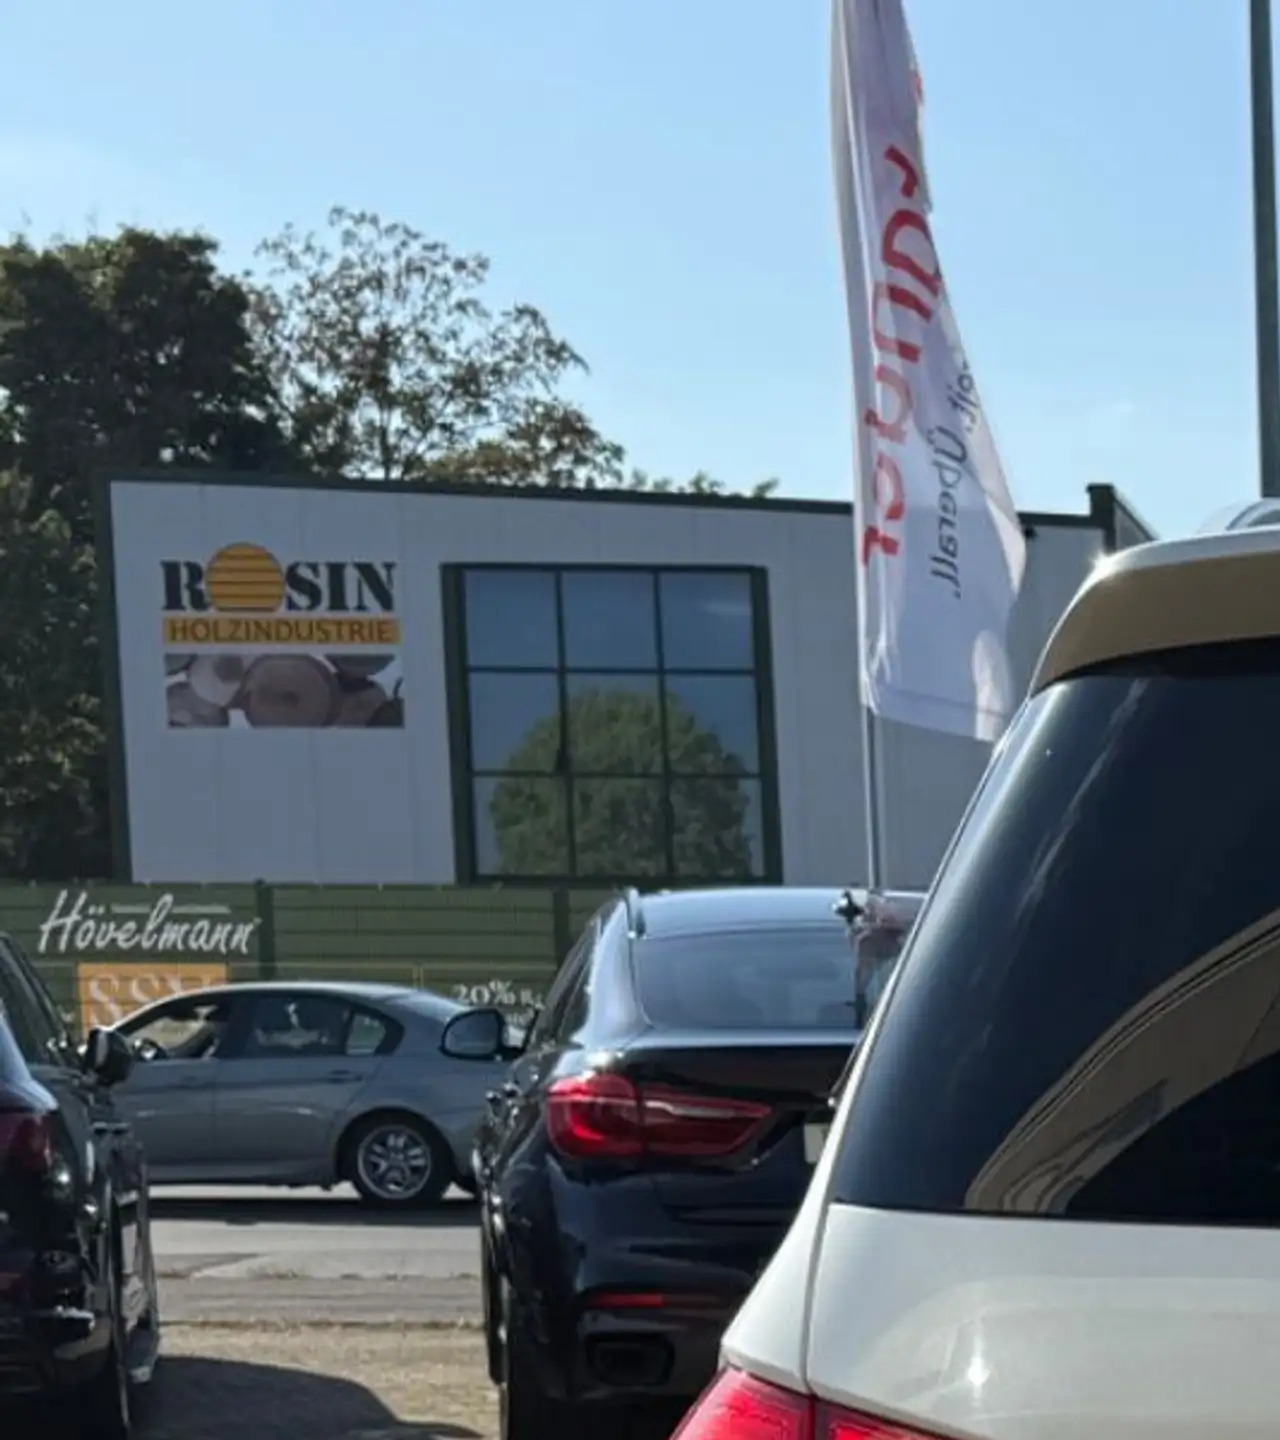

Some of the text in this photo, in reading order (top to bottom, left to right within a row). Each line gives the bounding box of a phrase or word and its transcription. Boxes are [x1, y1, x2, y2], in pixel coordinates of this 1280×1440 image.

[159, 541, 397, 613] ROSIN
[169, 618, 395, 643] HOLZINDUSTRIE
[37, 888, 263, 954] Hövelmann
